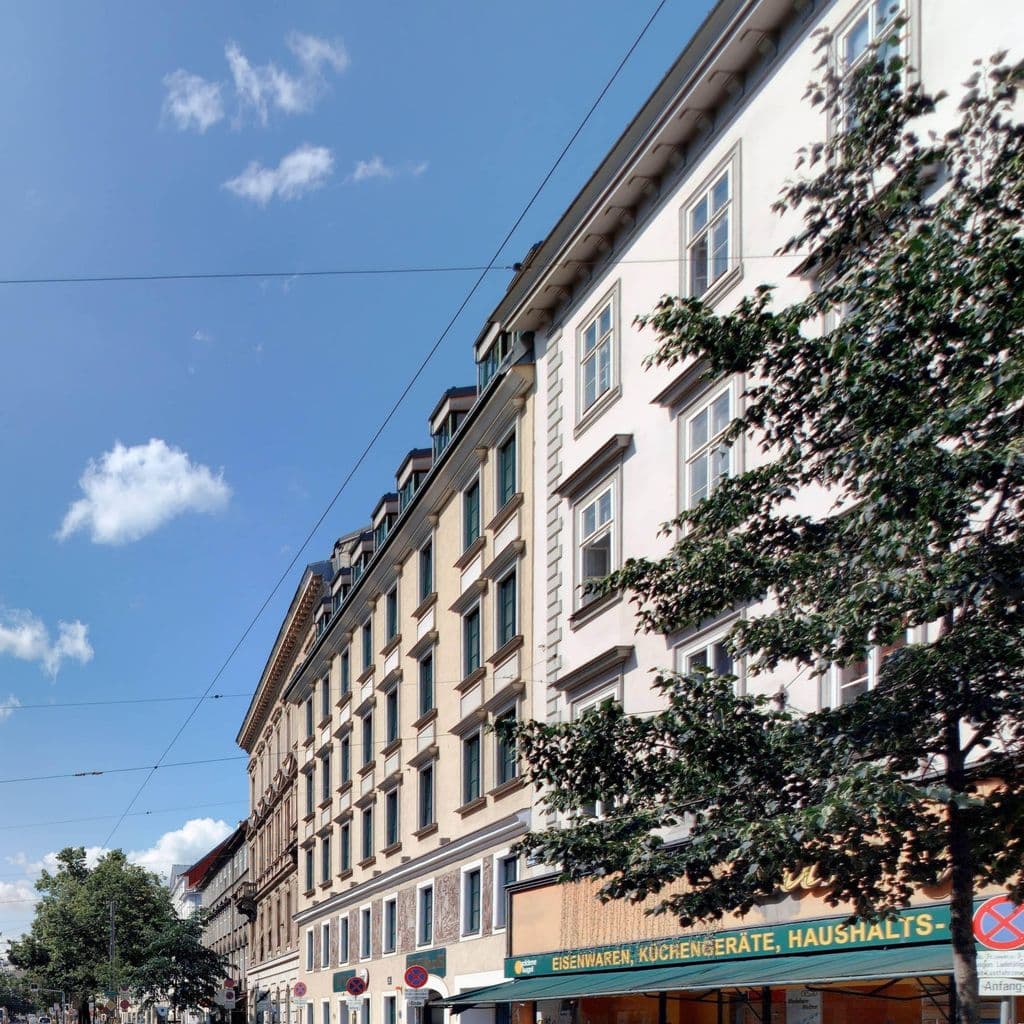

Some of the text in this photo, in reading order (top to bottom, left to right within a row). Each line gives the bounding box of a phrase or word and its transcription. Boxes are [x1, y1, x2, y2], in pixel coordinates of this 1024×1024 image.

[552, 913, 945, 971] EISENWAREN, KÜCHENGERÄTE, HAUSHALTS-
